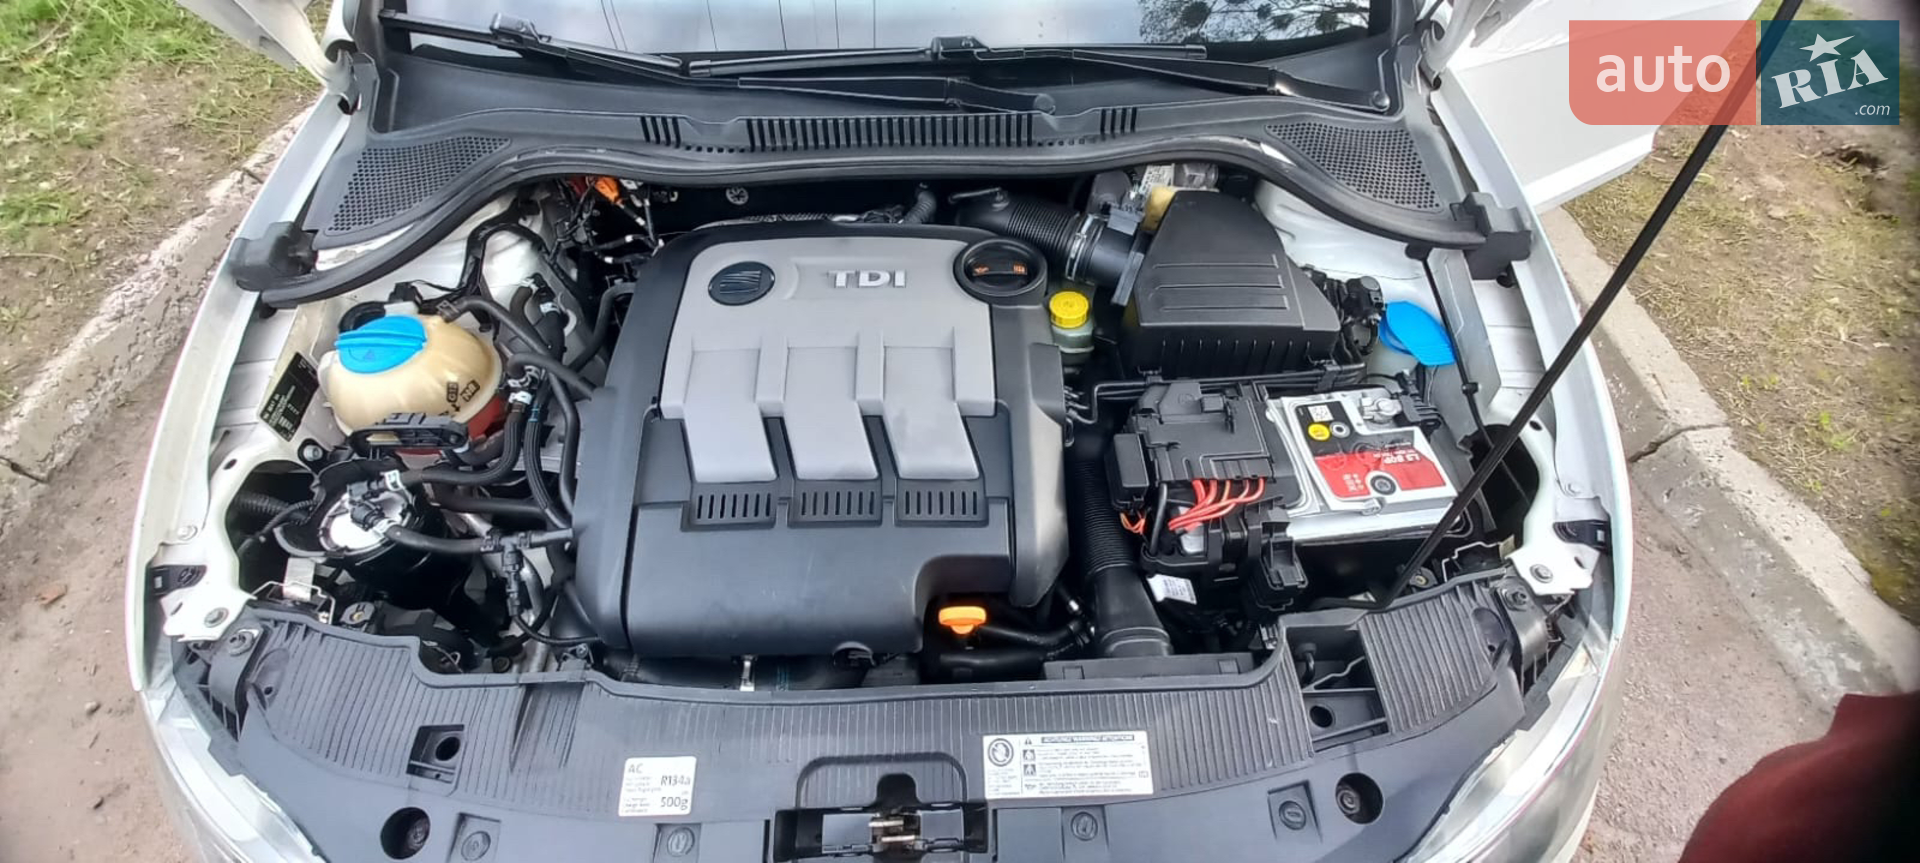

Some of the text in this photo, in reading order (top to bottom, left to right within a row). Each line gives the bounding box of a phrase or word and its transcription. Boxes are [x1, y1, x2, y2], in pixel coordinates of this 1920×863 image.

[827, 269, 906, 288] TDI
[628, 762, 644, 774] AC
[660, 774, 691, 786] R134a
[660, 796, 689, 811] 500g
